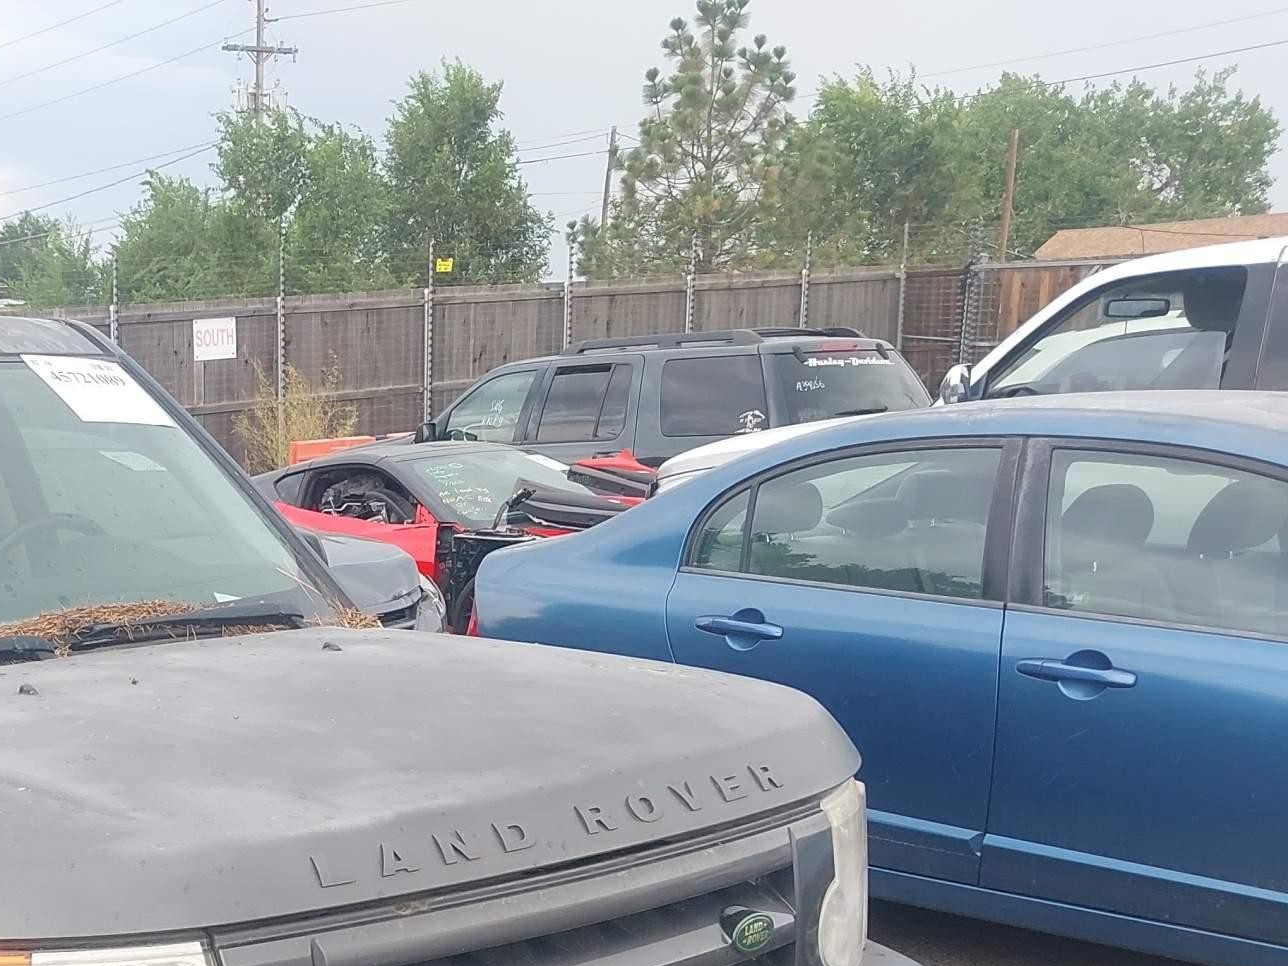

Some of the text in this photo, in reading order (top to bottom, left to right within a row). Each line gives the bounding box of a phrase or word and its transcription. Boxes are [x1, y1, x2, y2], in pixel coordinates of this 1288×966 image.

[195, 328, 234, 347] SOUTH
[50, 371, 126, 387] 45721089
[310, 764, 785, 888] LAND ROVER
[744, 921, 763, 936] LAND
